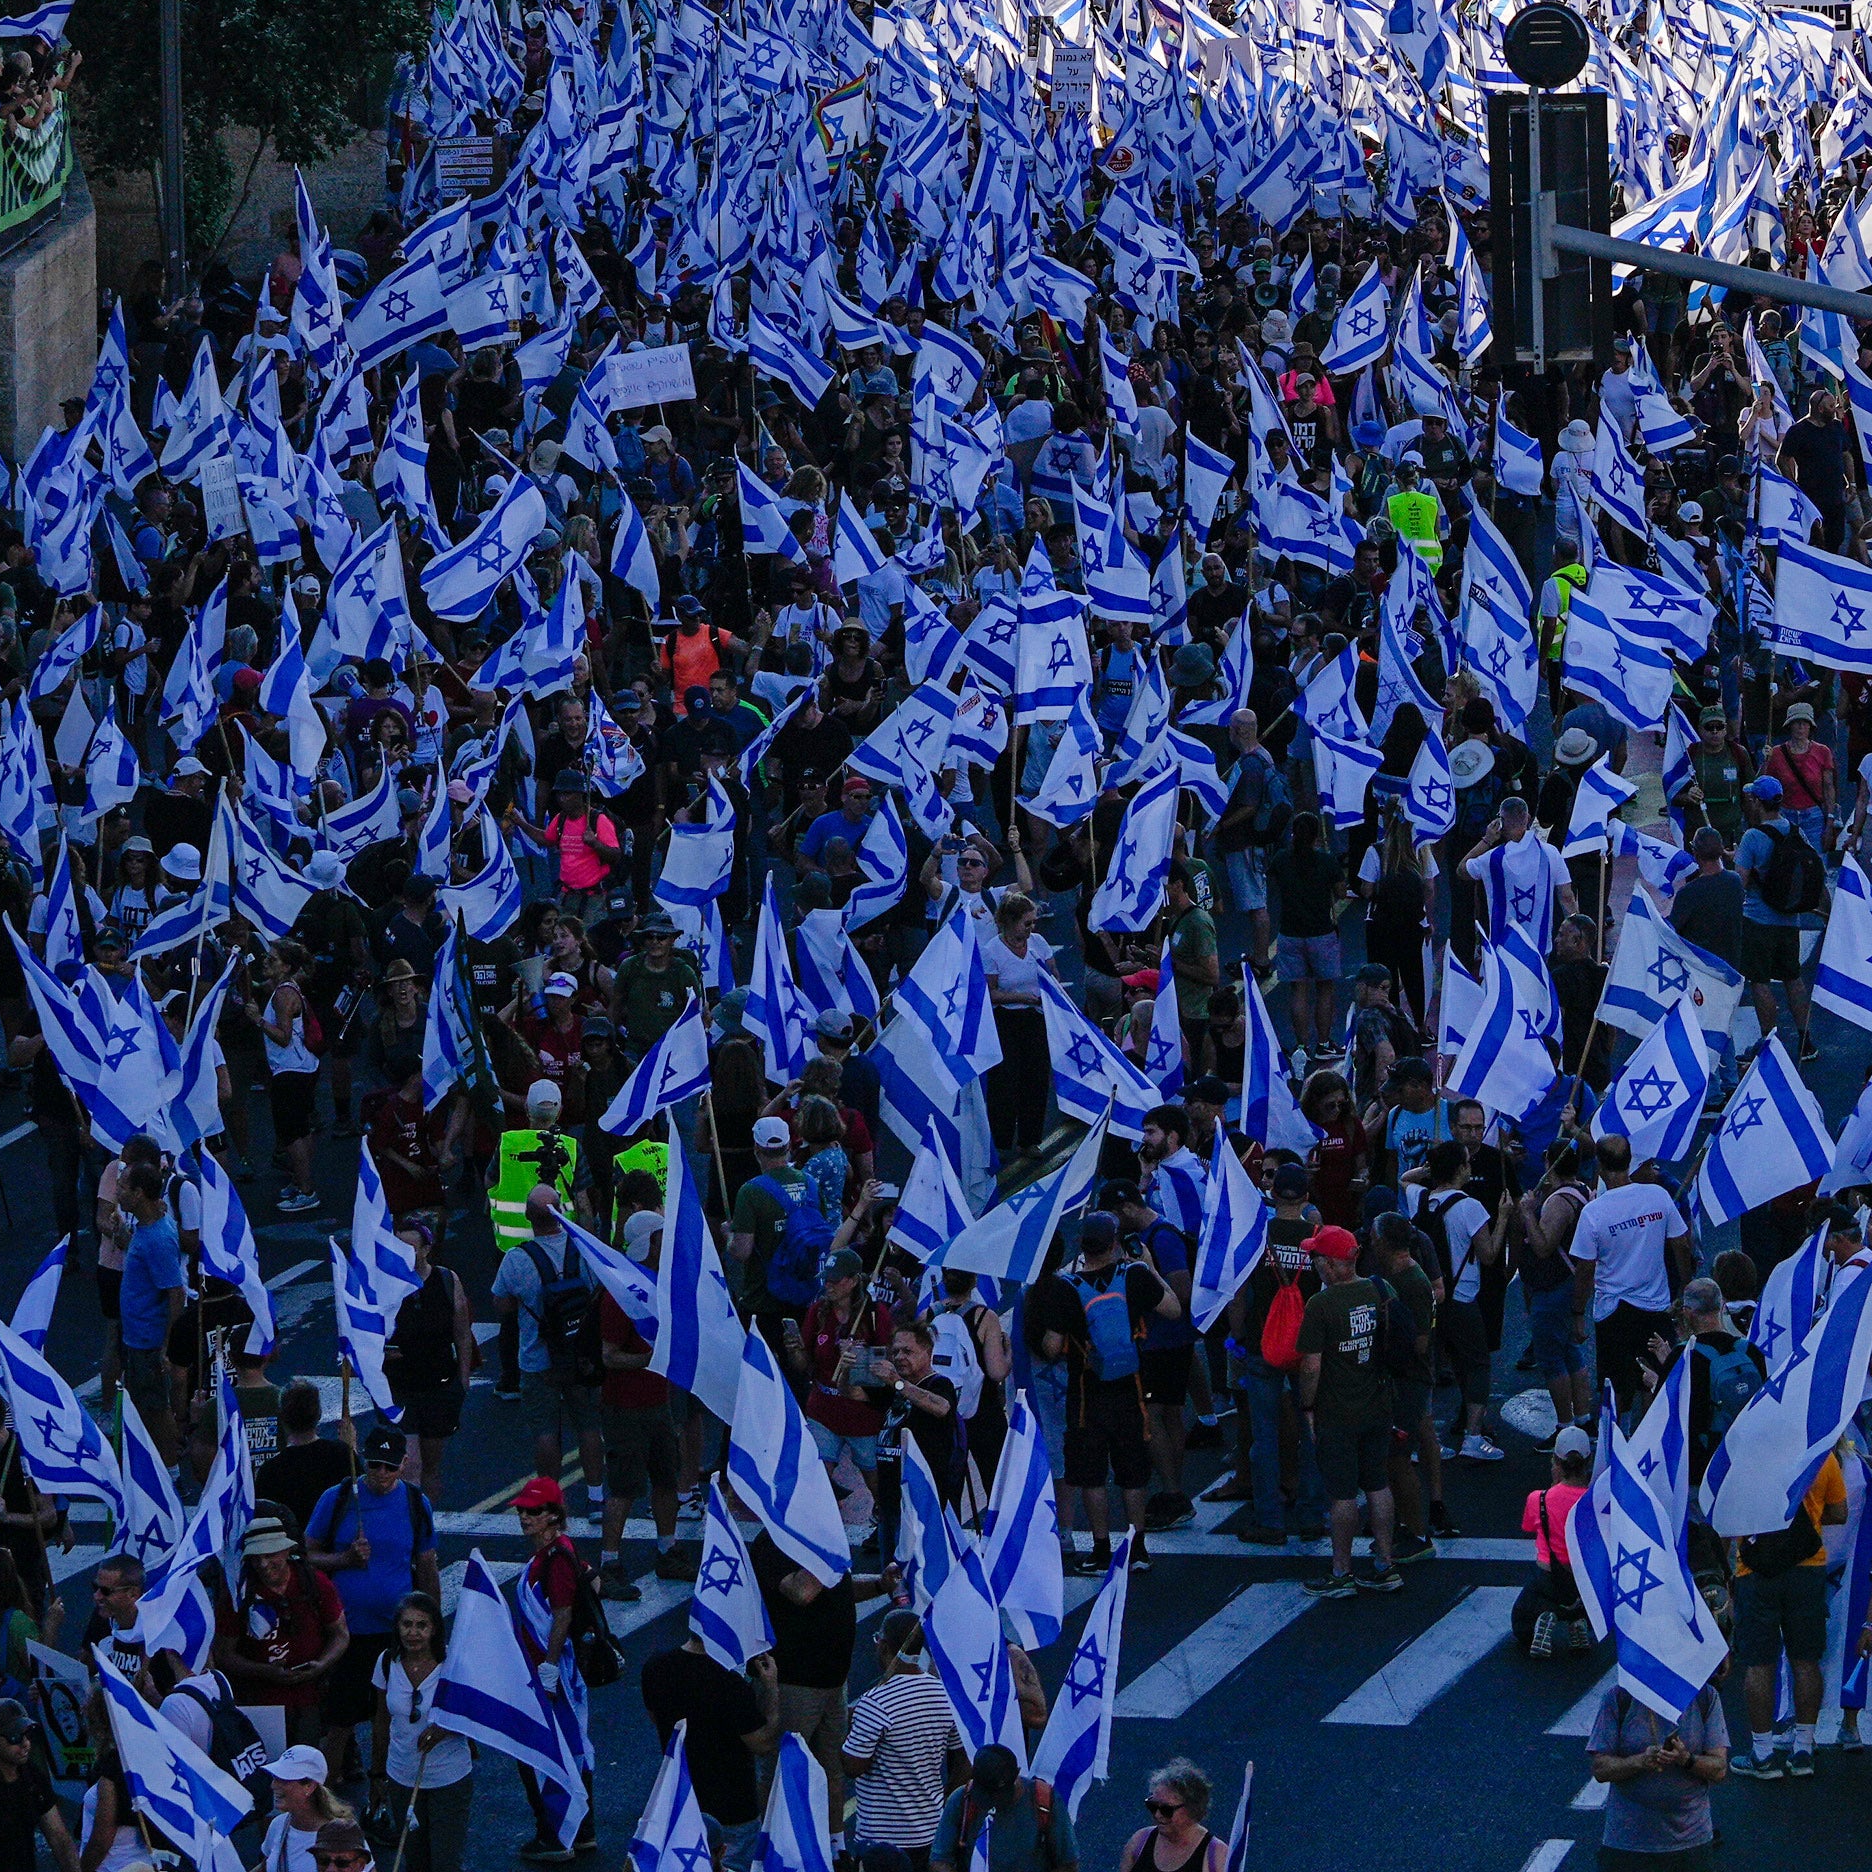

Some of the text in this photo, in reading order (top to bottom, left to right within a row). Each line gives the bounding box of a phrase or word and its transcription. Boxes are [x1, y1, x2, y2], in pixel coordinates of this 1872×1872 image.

[1055, 52, 1093, 63] לא נמות
[1067, 66, 1079, 76] על
[1054, 80, 1090, 94] קידוש
